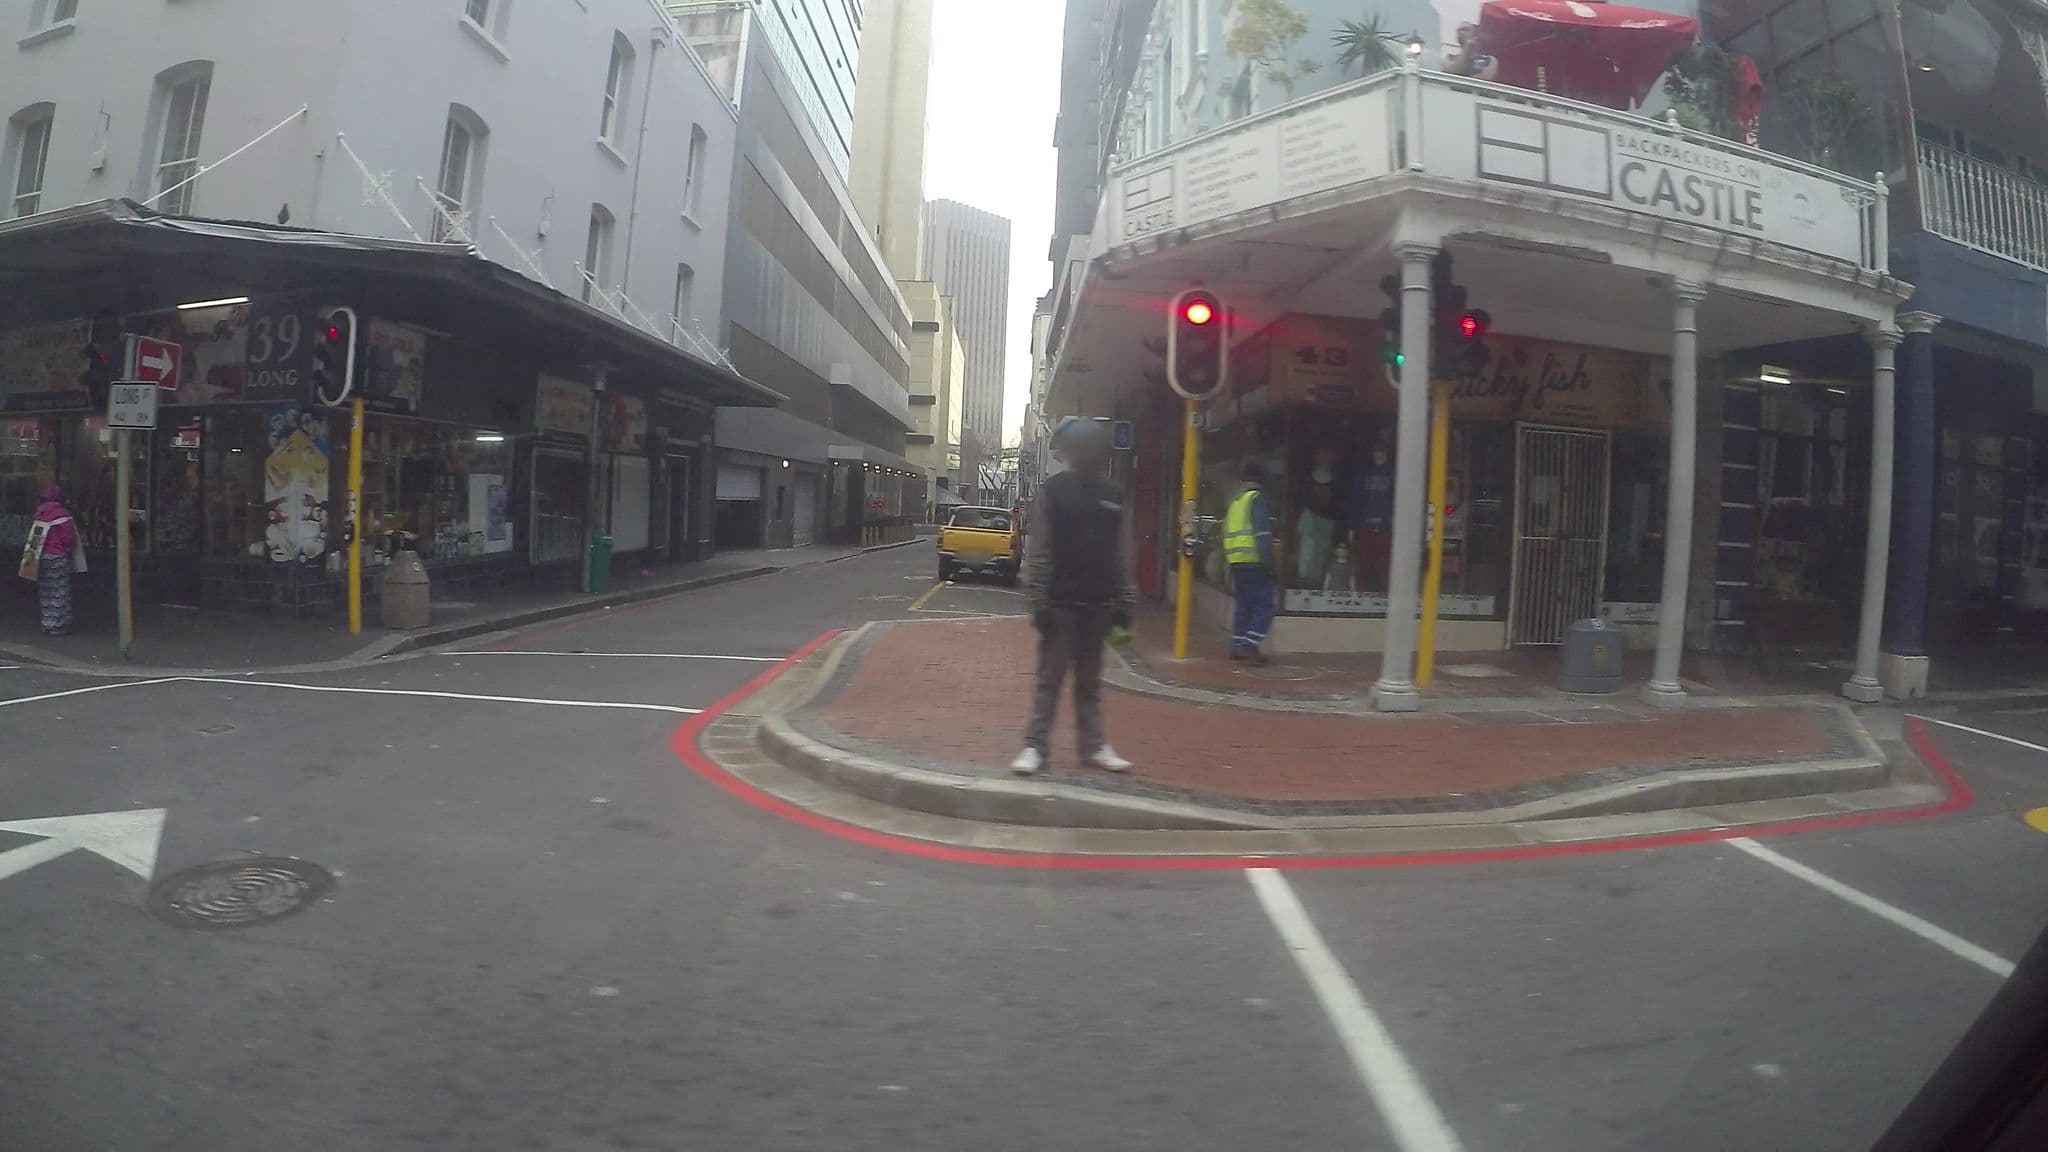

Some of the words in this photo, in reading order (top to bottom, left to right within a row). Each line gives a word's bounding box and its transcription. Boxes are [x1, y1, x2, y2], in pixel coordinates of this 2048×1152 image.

[1616, 134, 1730, 174] BACKPACKERS
[1737, 164, 1760, 180] ON
[1619, 161, 1764, 232] CASTLE
[1127, 207, 1174, 237] CASTLE
[250, 313, 301, 362] 39
[1295, 346, 1349, 367] 43
[115, 388, 140, 405] LONG
[248, 368, 298, 388] LONG
[1534, 351, 1593, 410] fish
